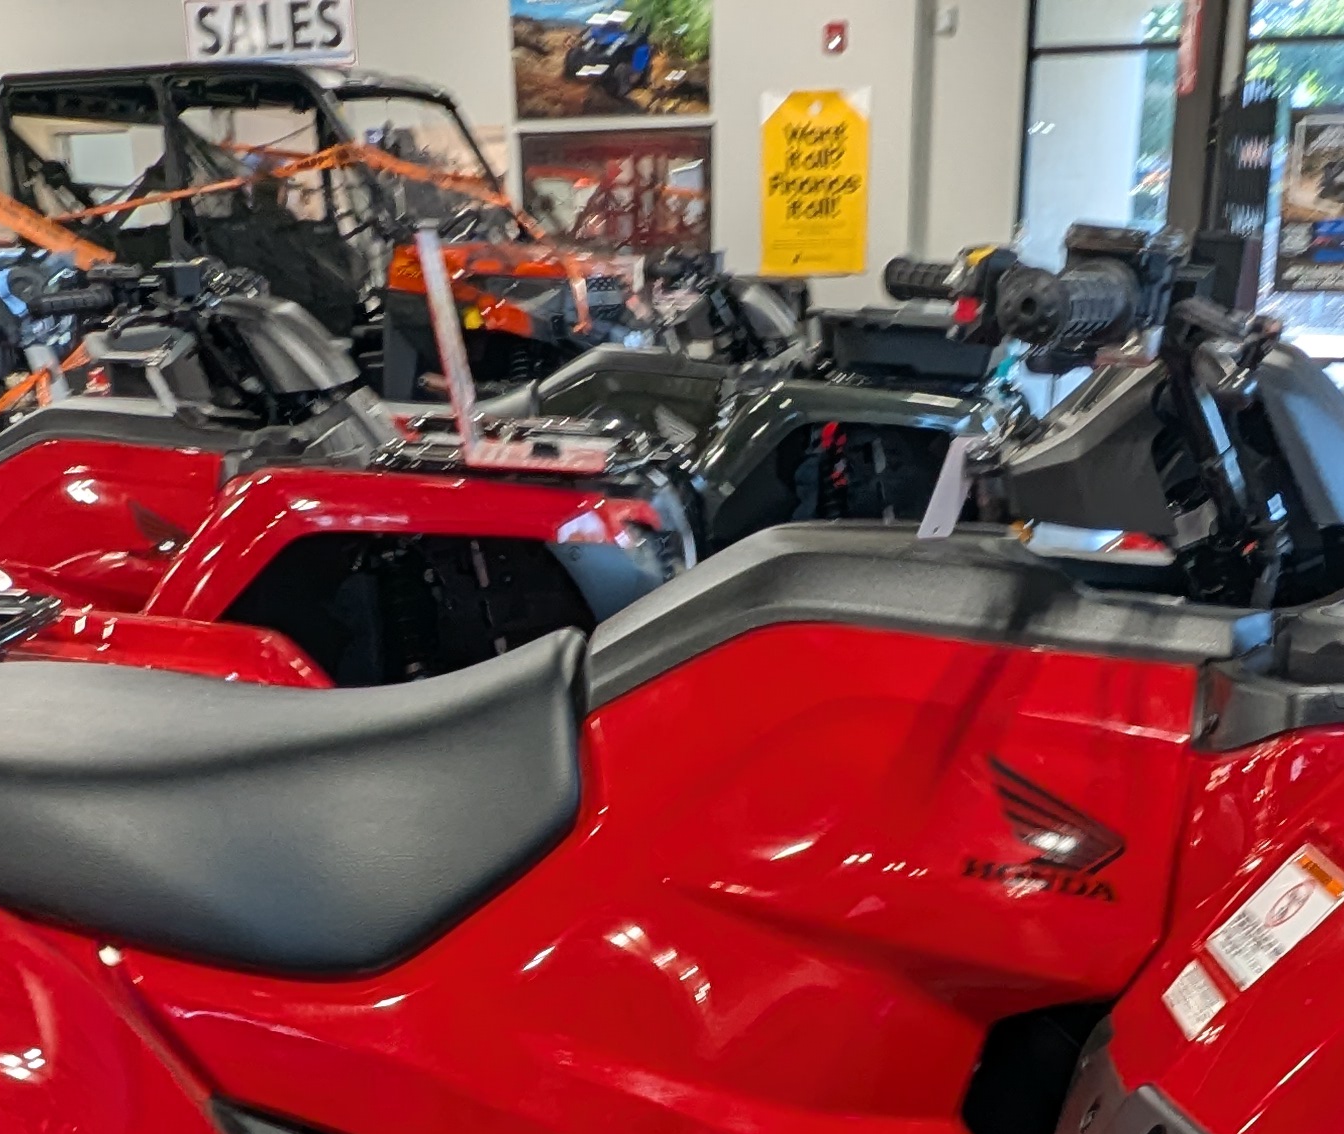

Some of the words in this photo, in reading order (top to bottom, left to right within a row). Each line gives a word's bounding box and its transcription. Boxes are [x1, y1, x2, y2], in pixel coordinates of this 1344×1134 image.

[196, 1, 344, 55] SALES
[784, 121, 848, 145] Want
[769, 173, 862, 197] Finance
[962, 859, 1117, 902] HONDA
